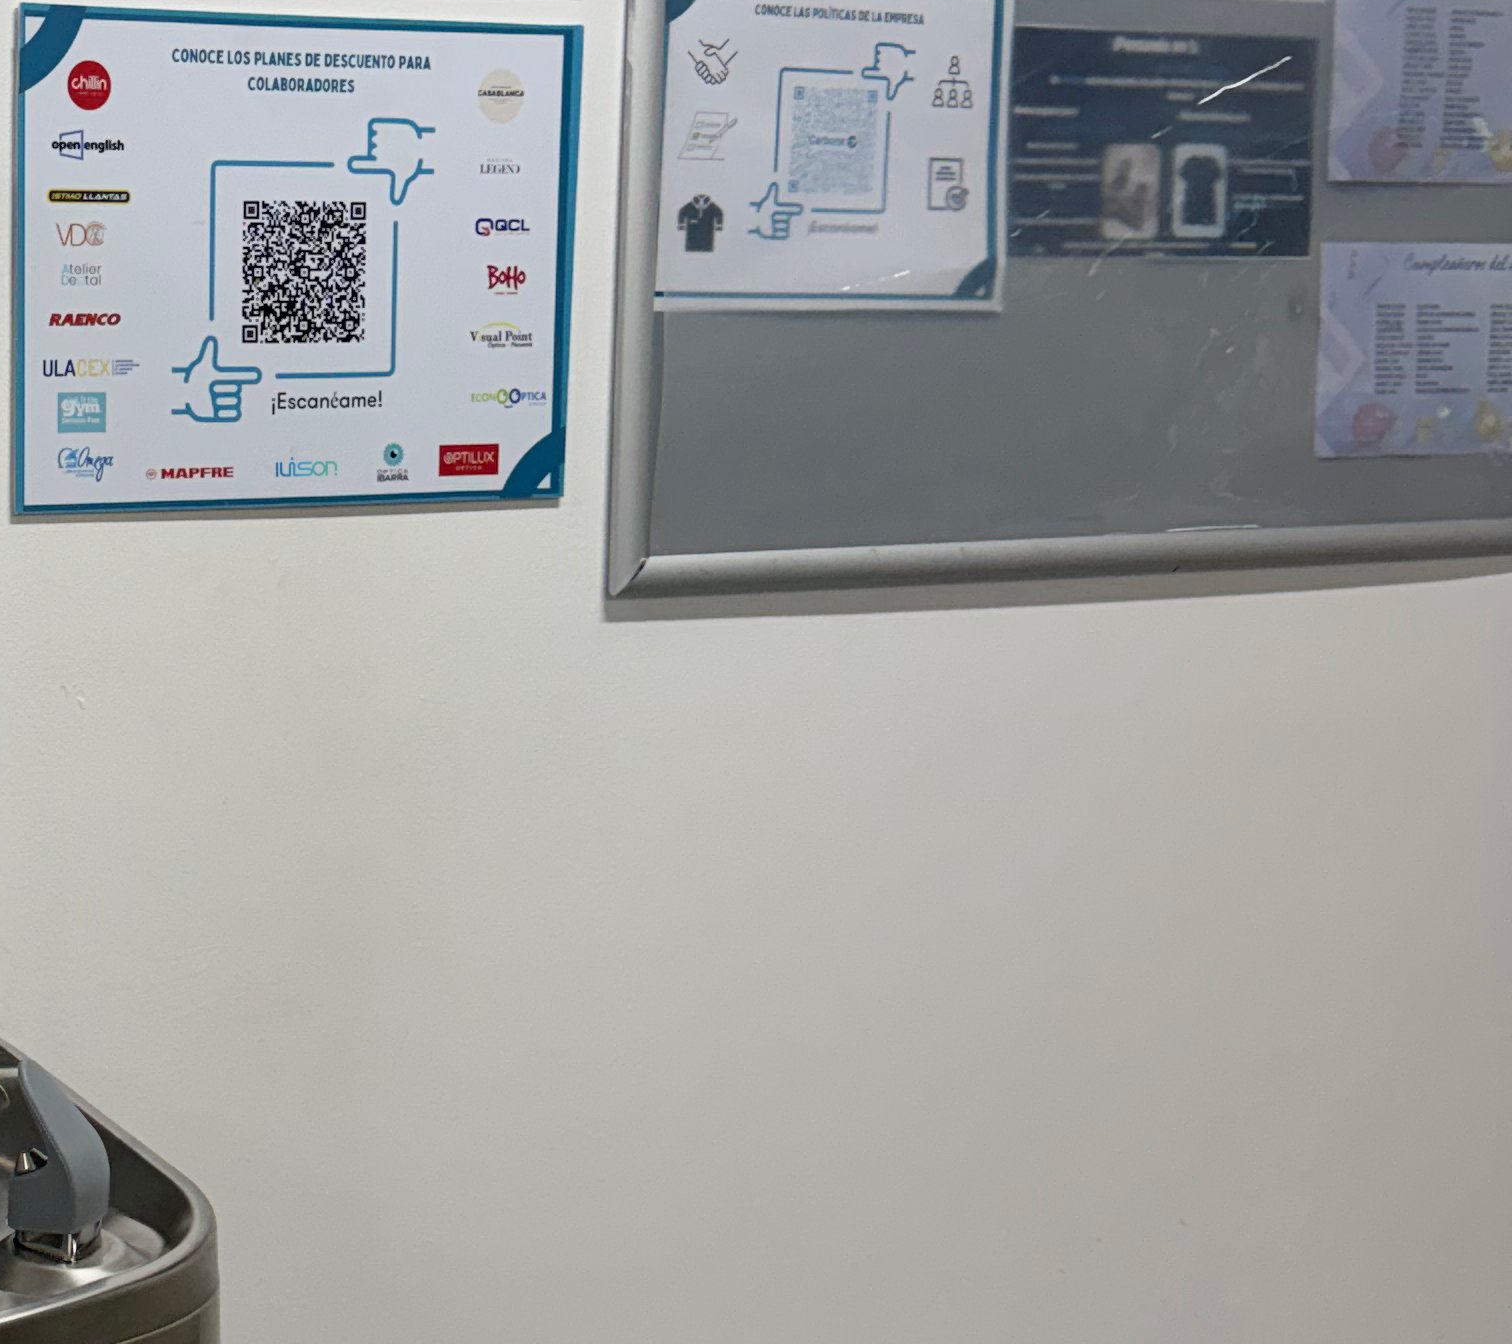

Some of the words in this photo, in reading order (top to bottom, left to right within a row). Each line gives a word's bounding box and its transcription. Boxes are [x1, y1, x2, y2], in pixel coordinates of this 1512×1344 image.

[754, 4, 792, 17] CONOCE
[793, 7, 810, 18] LAS
[858, 10, 870, 22] DE
[871, 11, 882, 23] LA
[884, 12, 924, 25] EMPRESA
[172, 48, 224, 64] CONOCE
[227, 50, 251, 65] LOS
[254, 51, 302, 66] PLANES
[305, 52, 321, 67] DE
[324, 53, 396, 69] DESCUENTO
[398, 55, 431, 70] PARA
[248, 76, 355, 93] COLABORADORES
[51, 140, 80, 152] open
[83, 139, 124, 153] english
[61, 275, 102, 287] Detal
[49, 313, 121, 326] RAENCO
[470, 330, 502, 342] Vsual
[505, 330, 532, 342] Point
[42, 359, 110, 377] ULACEX
[271, 391, 382, 415] ¡Escanéame!
[160, 466, 234, 479] MAPFRE
